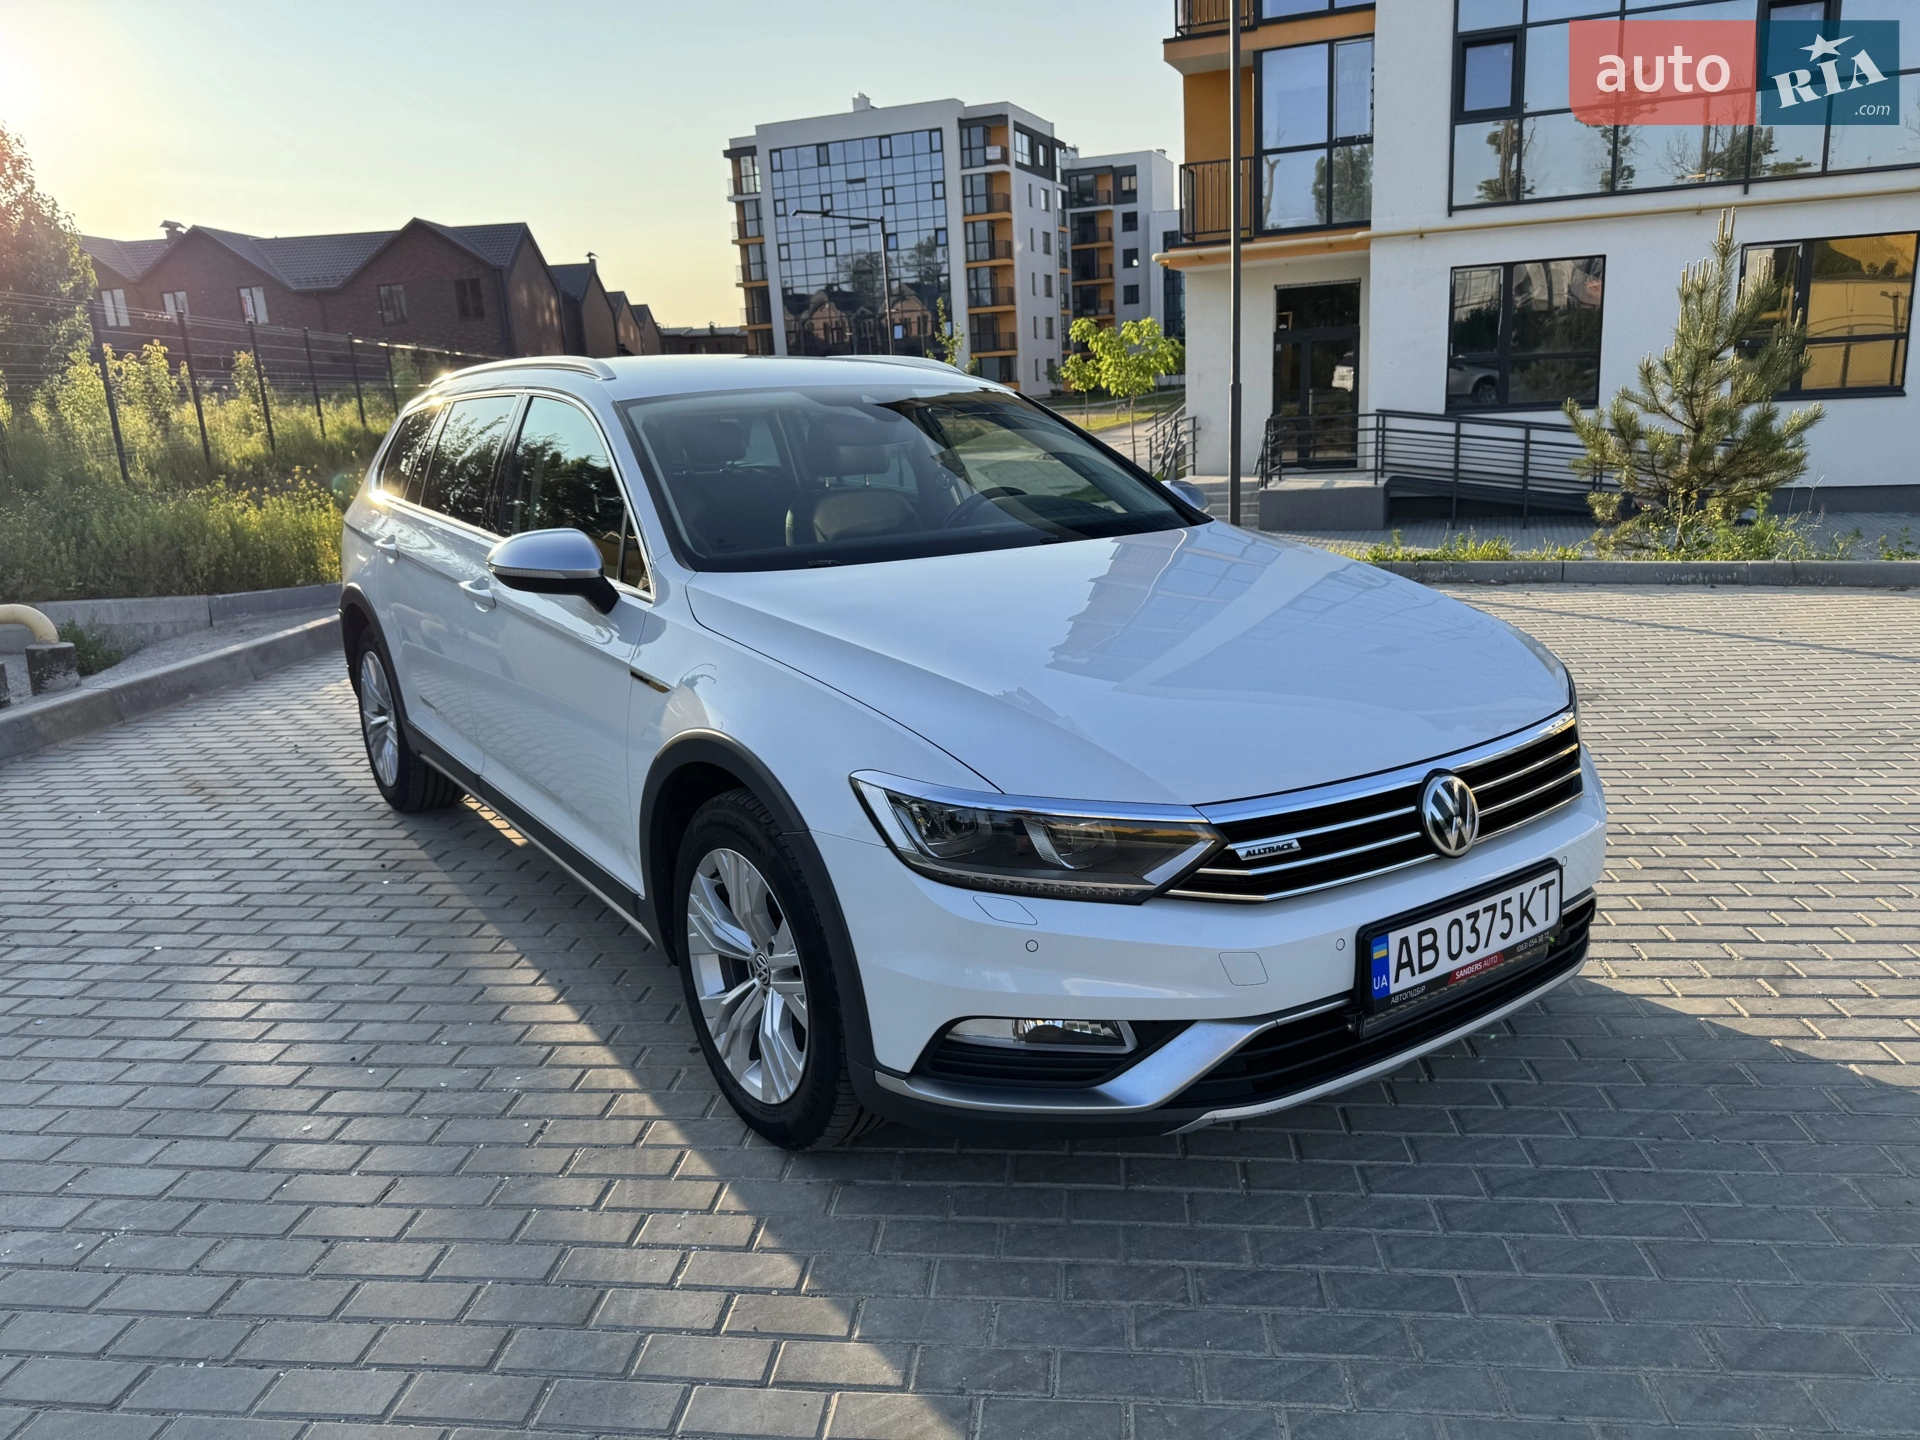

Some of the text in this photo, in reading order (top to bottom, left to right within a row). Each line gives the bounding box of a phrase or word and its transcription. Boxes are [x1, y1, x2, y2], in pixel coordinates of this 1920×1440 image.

[1244, 841, 1294, 858] ALLTRACK
[1455, 955, 1498, 980] SANDERS AUTO
[1373, 973, 1388, 991] UA
[1390, 985, 1426, 1004] АВТОПІДБІР
